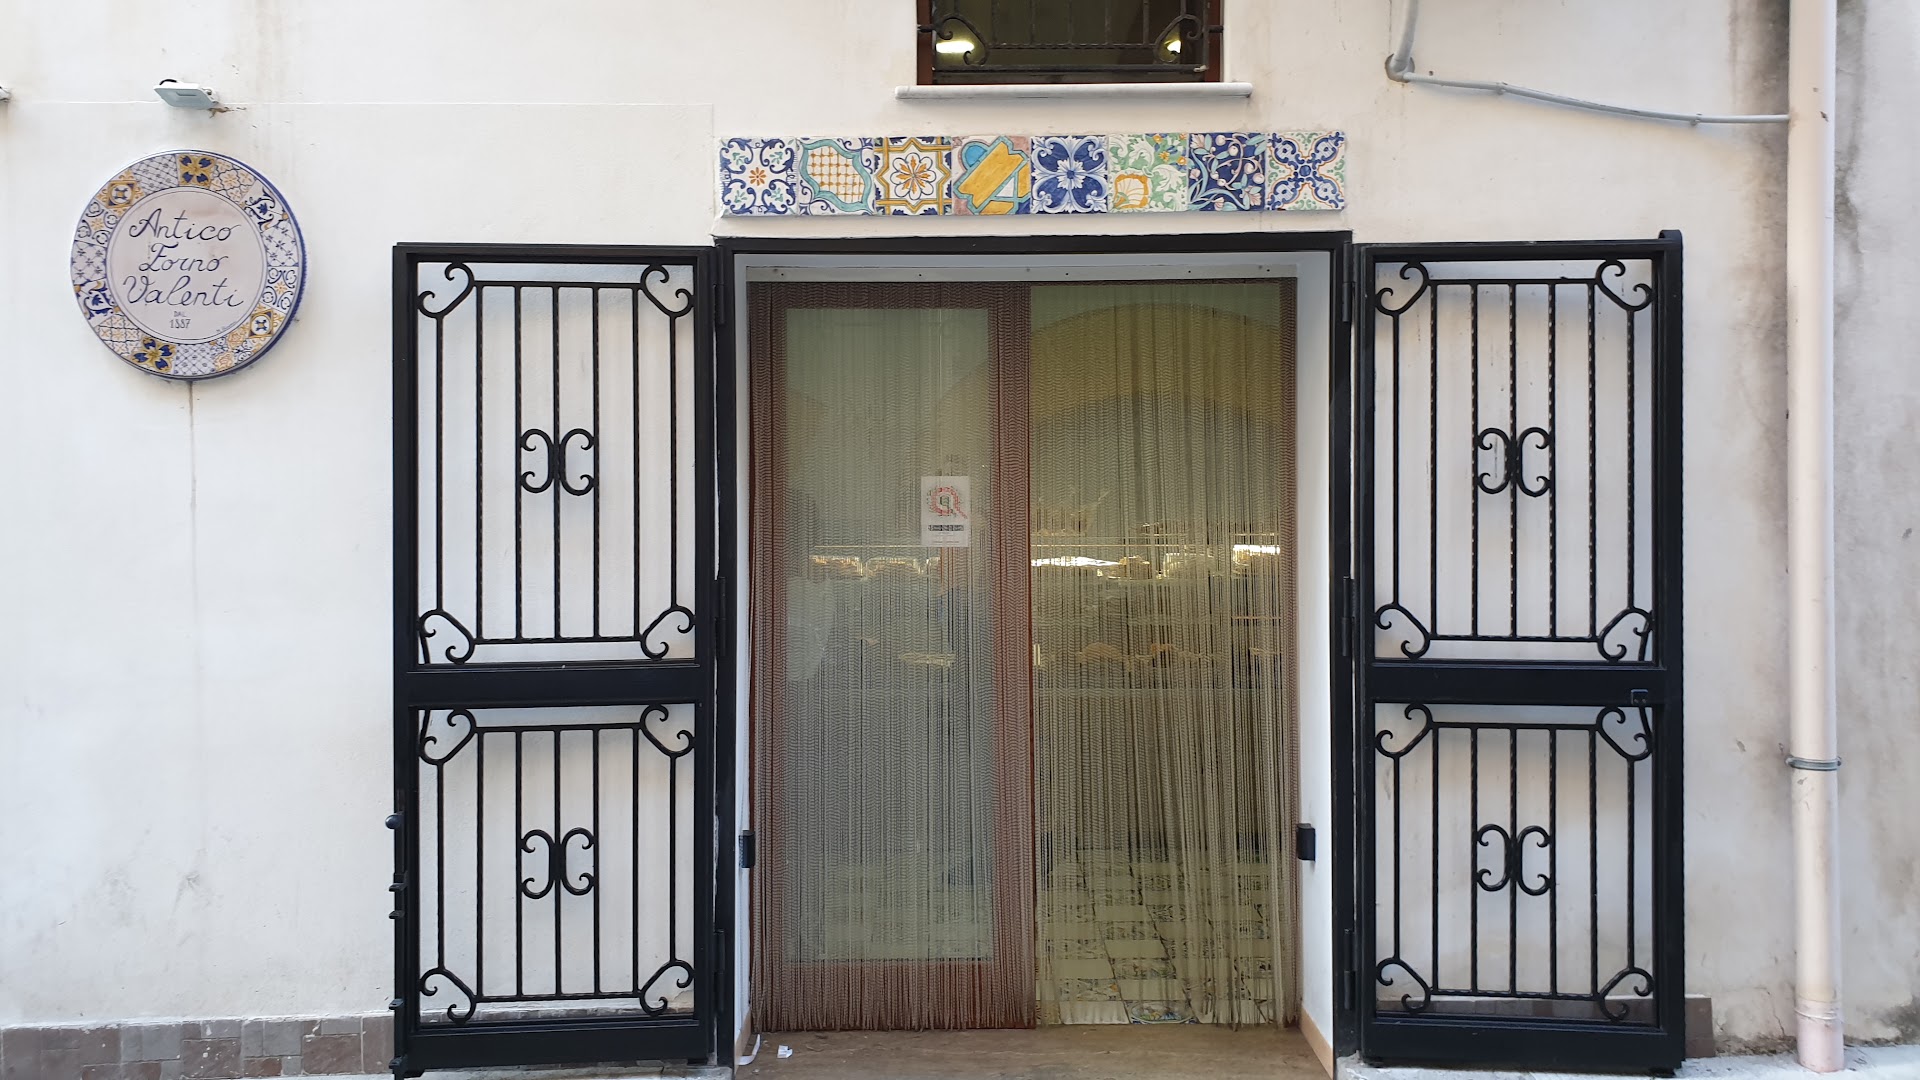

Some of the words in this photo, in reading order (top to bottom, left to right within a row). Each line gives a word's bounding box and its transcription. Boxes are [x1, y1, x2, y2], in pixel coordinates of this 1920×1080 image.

[129, 208, 241, 241] Antico
[138, 242, 229, 272] Forno
[123, 275, 244, 307] Valenti
